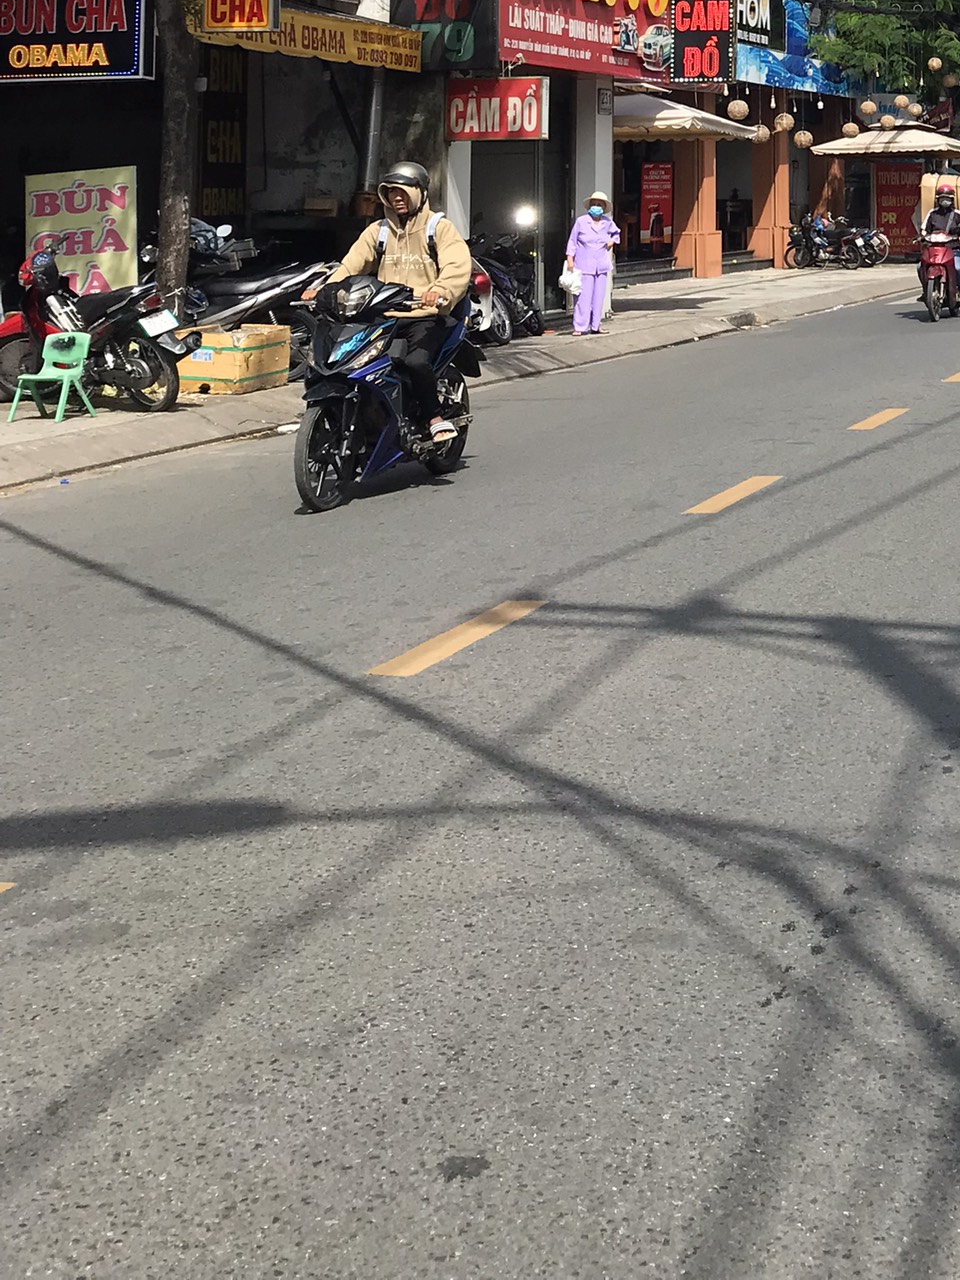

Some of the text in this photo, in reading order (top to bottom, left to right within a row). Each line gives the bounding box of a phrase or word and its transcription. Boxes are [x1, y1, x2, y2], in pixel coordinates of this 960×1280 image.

[301, 25, 347, 55] OBAMA
[410, 22, 475, 63] 79
[508, 3, 522, 29] LÃI
[523, 5, 545, 33] SUẤT
[587, 19, 599, 43] GIÁ
[599, 24, 613, 45] CAO
[8, 42, 110, 68] OBAMA
[370, 48, 389, 64] 0393
[683, 36, 720, 78] ĐỒ
[450, 84, 538, 133] CẦM ĐỒ
[29, 179, 129, 218] BÚN
[881, 212, 897, 224] PR
